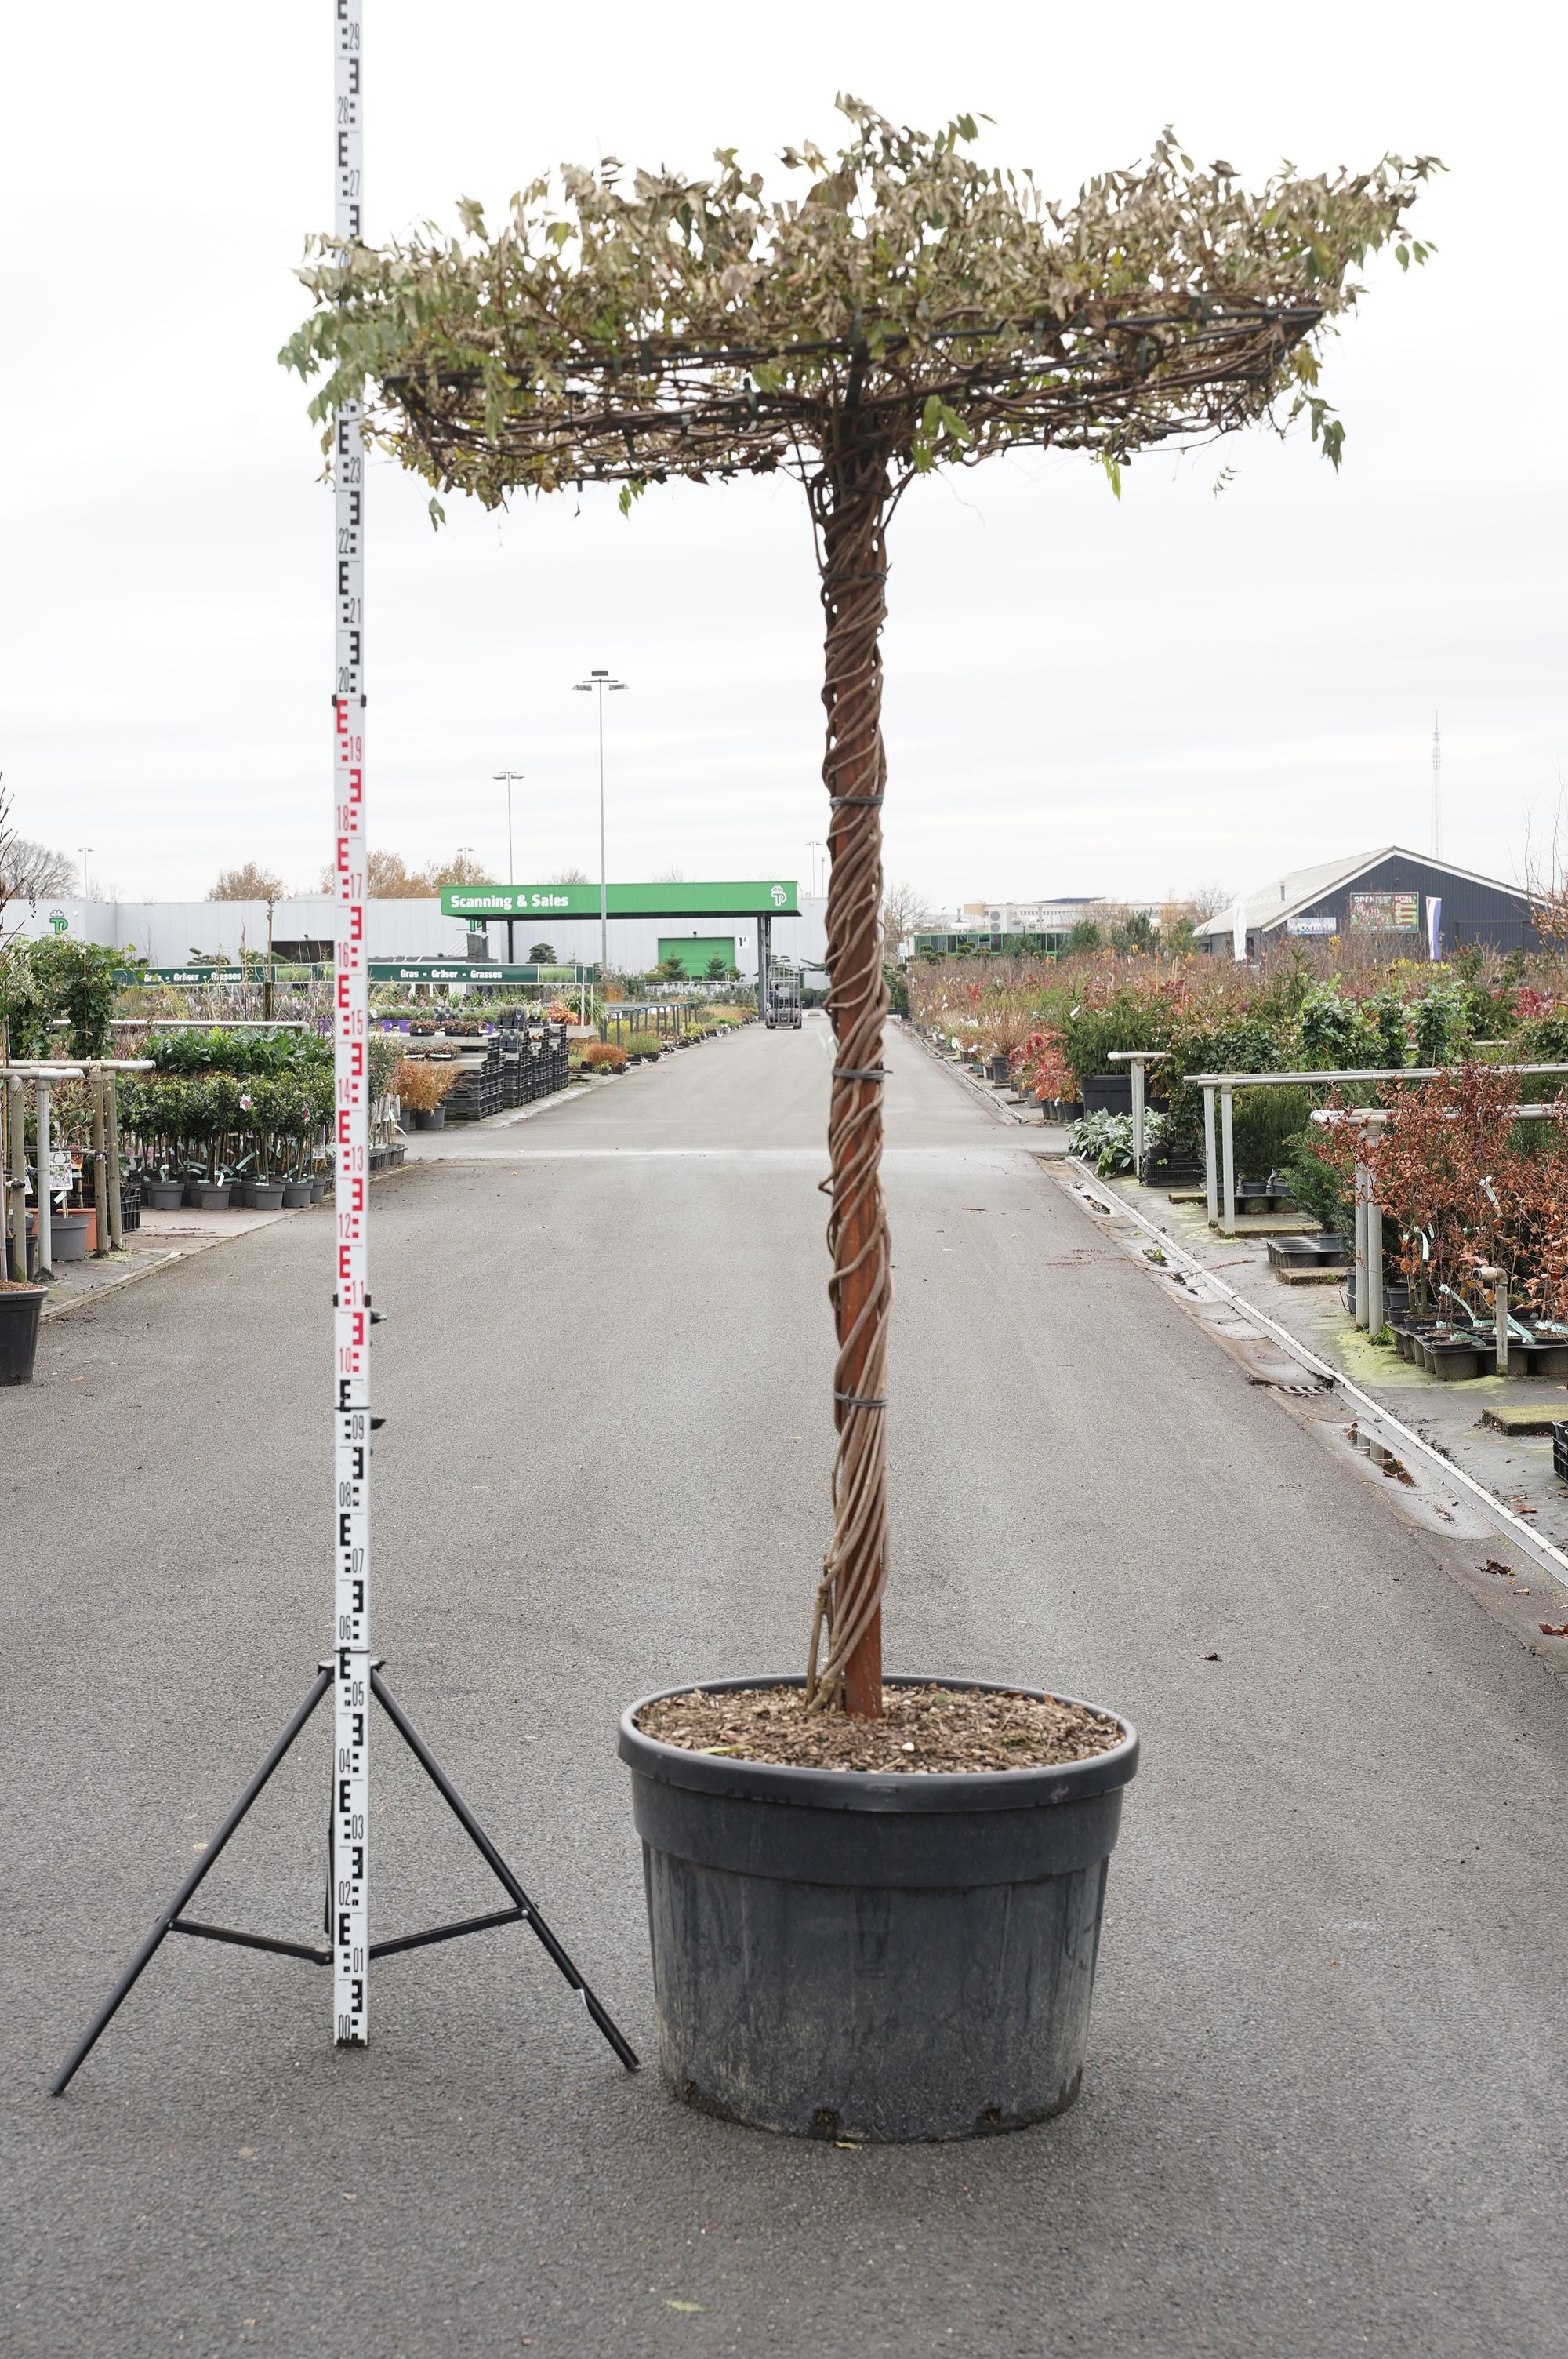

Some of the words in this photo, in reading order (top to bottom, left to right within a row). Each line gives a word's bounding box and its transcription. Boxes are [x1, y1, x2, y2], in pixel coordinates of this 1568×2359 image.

[349, 22, 360, 50] 29
[338, 96, 349, 124] 28
[349, 169, 361, 197] 27
[350, 456, 361, 484] 23
[339, 527, 350, 554] 22
[350, 598, 361, 624] 21
[339, 667, 350, 693] 20
[350, 736, 362, 762] 19
[337, 805, 350, 831] 18
[350, 872, 362, 900] 17
[451, 895, 512, 910] Scanning
[517, 894, 528, 907] &
[532, 894, 569, 907] Sales
[338, 941, 350, 968] 16
[144, 973, 162, 983] Grs
[400, 969, 419, 978] Gras
[431, 969, 458, 978] Gräser
[470, 969, 503, 979] Grasses
[351, 1009, 363, 1035] 15
[339, 1078, 350, 1104] 14
[352, 1145, 364, 1172] 13
[339, 1212, 351, 1238] 12
[353, 1280, 365, 1306] 11
[339, 1347, 351, 1372] 10
[353, 1414, 364, 1440] 09
[339, 1481, 351, 1507] 08
[353, 1548, 365, 1574] 07
[339, 1615, 351, 1640] 06
[353, 1681, 365, 1707] 05
[339, 1748, 350, 1774] 04
[352, 1814, 364, 1840] 03
[339, 1881, 350, 1906] 02
[354, 1947, 364, 1972] 01
[339, 2014, 350, 2039] 00
